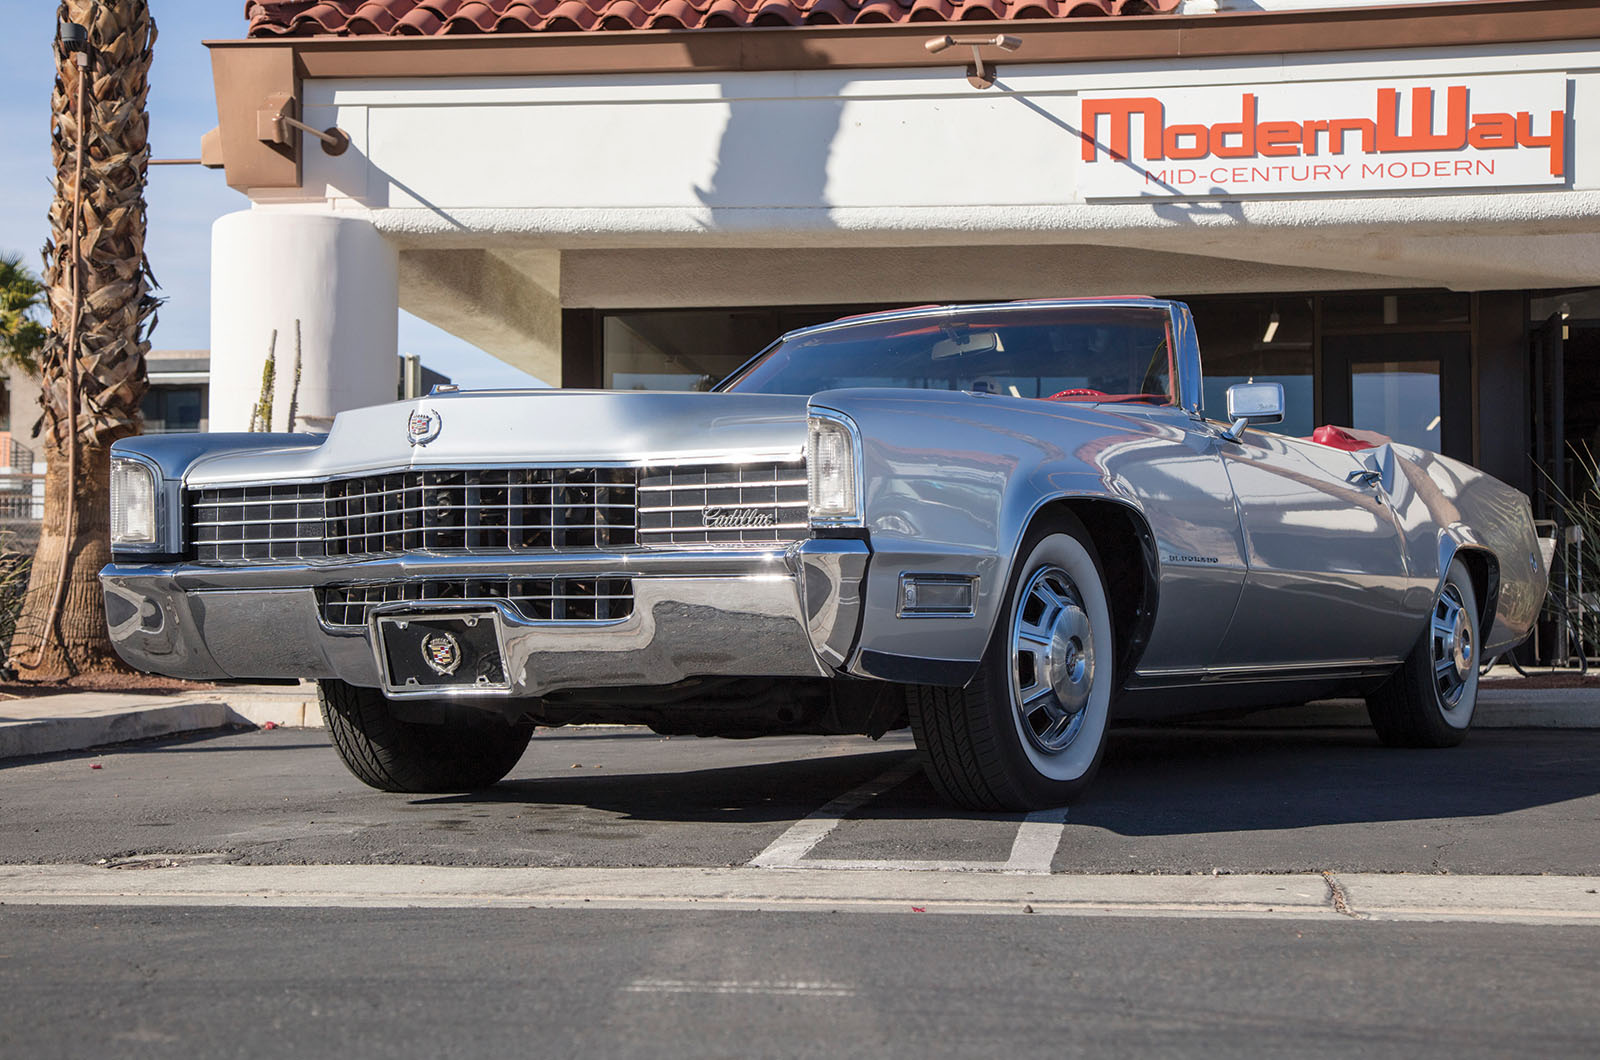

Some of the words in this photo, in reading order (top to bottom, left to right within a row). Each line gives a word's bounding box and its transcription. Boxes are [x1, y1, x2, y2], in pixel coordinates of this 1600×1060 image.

[1145, 163, 1350, 185] MID-CENTURY
[1361, 159, 1495, 179] MODERN
[702, 507, 774, 528] Cadillac
